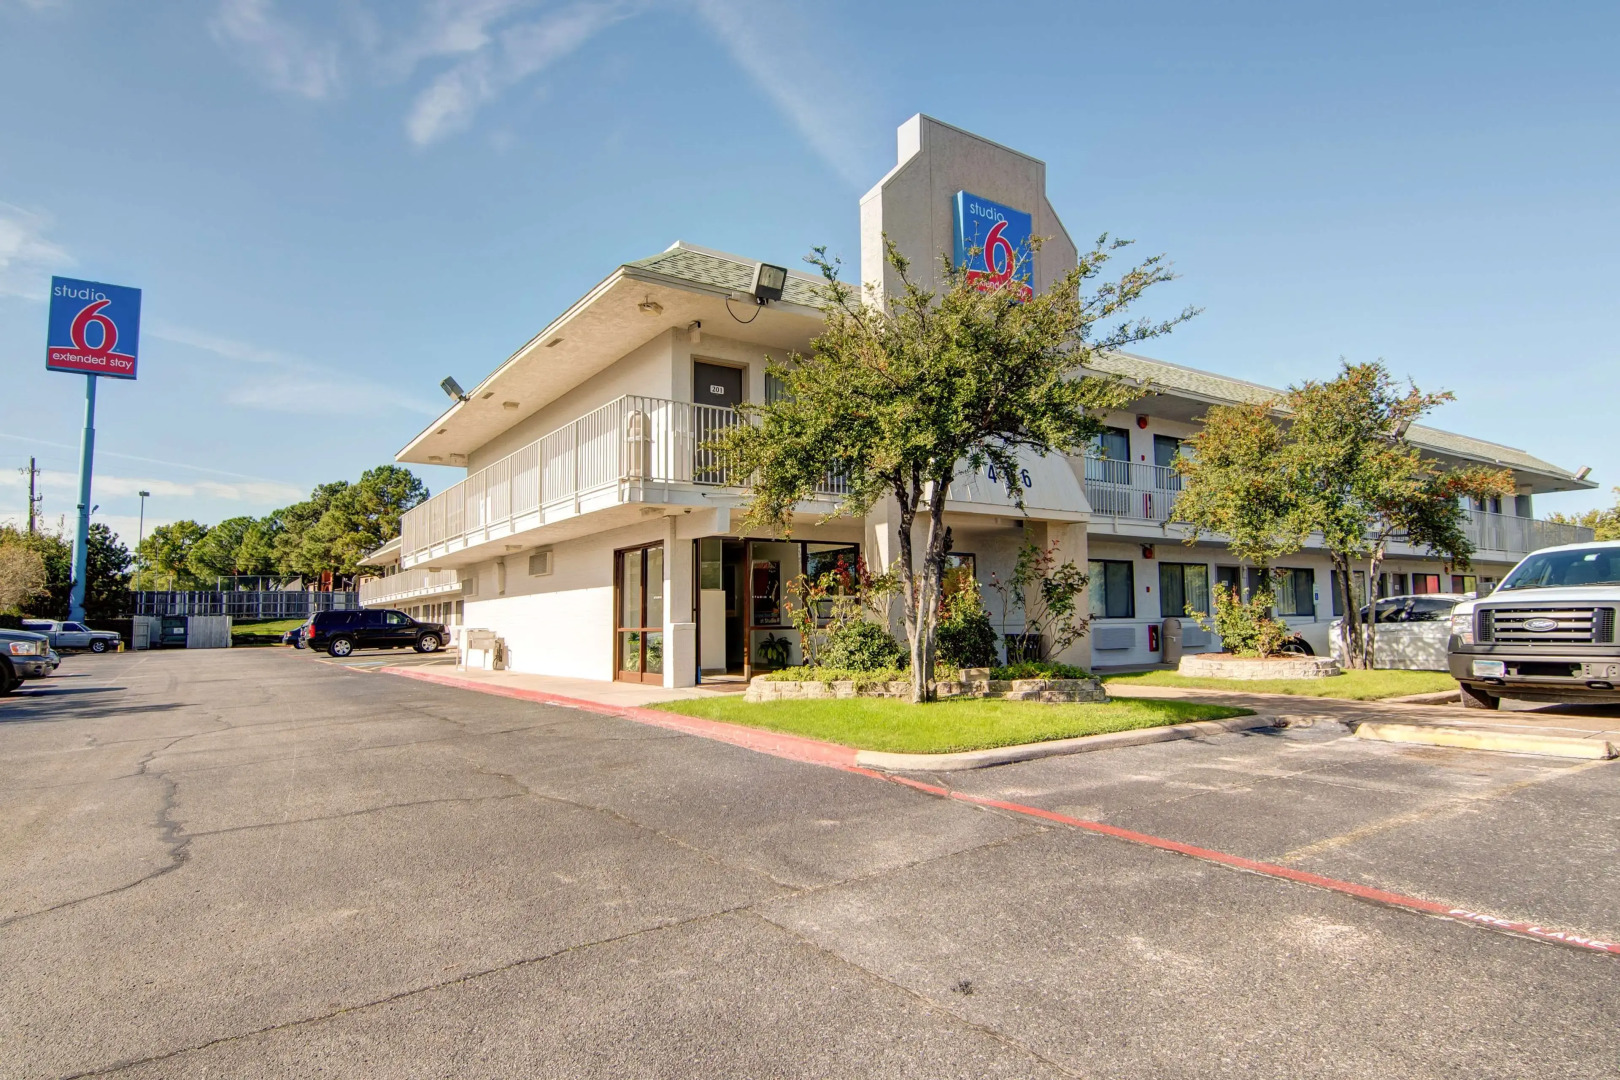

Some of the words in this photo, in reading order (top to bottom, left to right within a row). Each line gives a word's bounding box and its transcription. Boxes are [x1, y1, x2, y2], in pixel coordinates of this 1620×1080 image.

[969, 202, 1005, 221] studio
[984, 220, 1015, 277] 6
[53, 285, 106, 301] studio
[70, 299, 118, 352] 6
[52, 353, 106, 365] extended
[109, 358, 133, 370] stay
[711, 386, 723, 394] 201
[987, 464, 1032, 488] 46
[1449, 909, 1512, 926] FIRE
[1527, 927, 1613, 949] LANE
